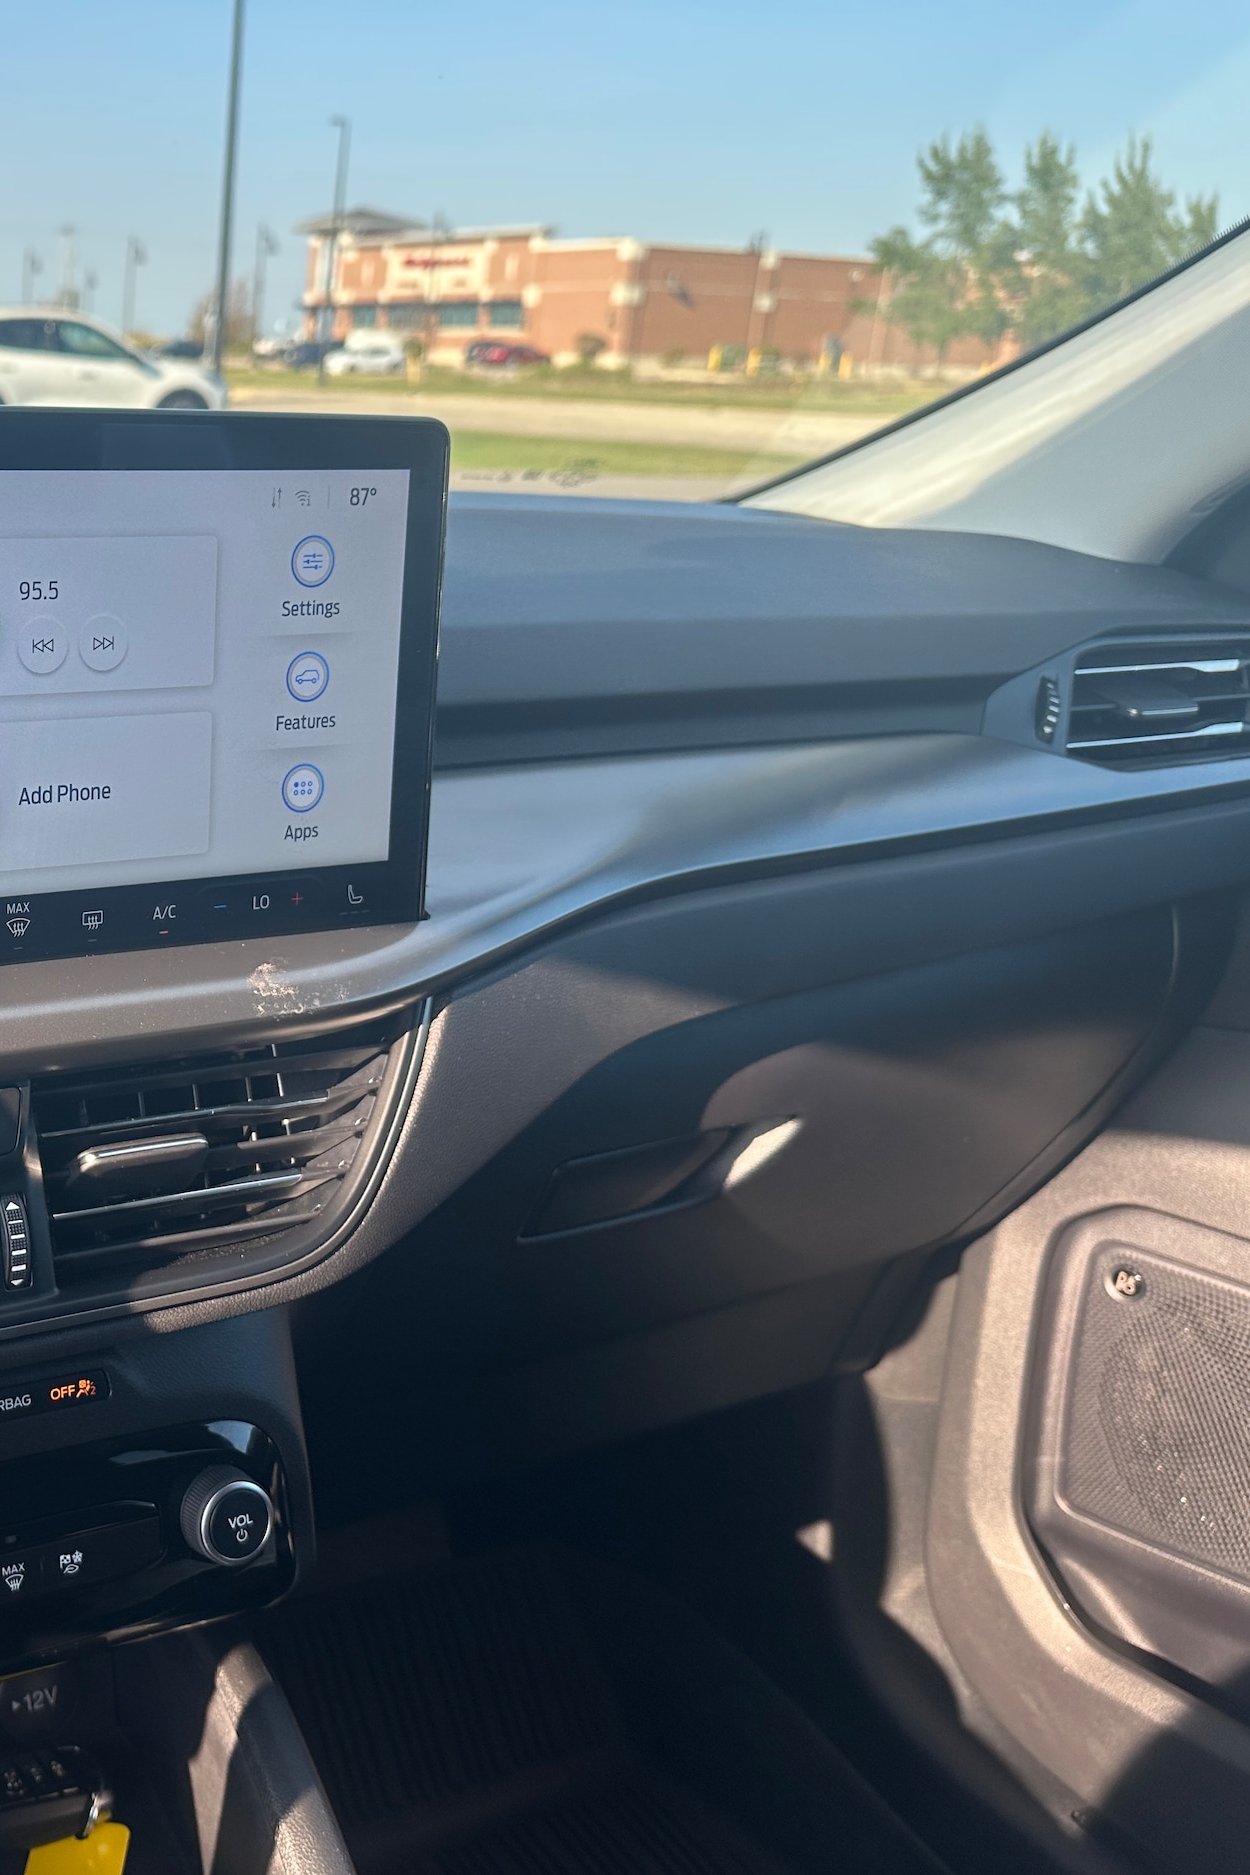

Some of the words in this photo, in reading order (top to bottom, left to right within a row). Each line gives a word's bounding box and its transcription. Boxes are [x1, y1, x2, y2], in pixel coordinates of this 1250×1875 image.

[18, 580, 60, 602] 95.5
[280, 599, 341, 621] Settings
[274, 712, 337, 733] Features
[18, 785, 54, 807] Add
[56, 782, 112, 804] Phone
[283, 823, 320, 843] Apps
[6, 901, 31, 915] MAX
[252, 894, 270, 910] LO
[153, 904, 177, 923] A/C
[50, 1384, 76, 1401] OFF
[228, 1514, 253, 1529] VOL
[2, 1562, 26, 1576] MAX
[24, 1685, 58, 1712] 12V
